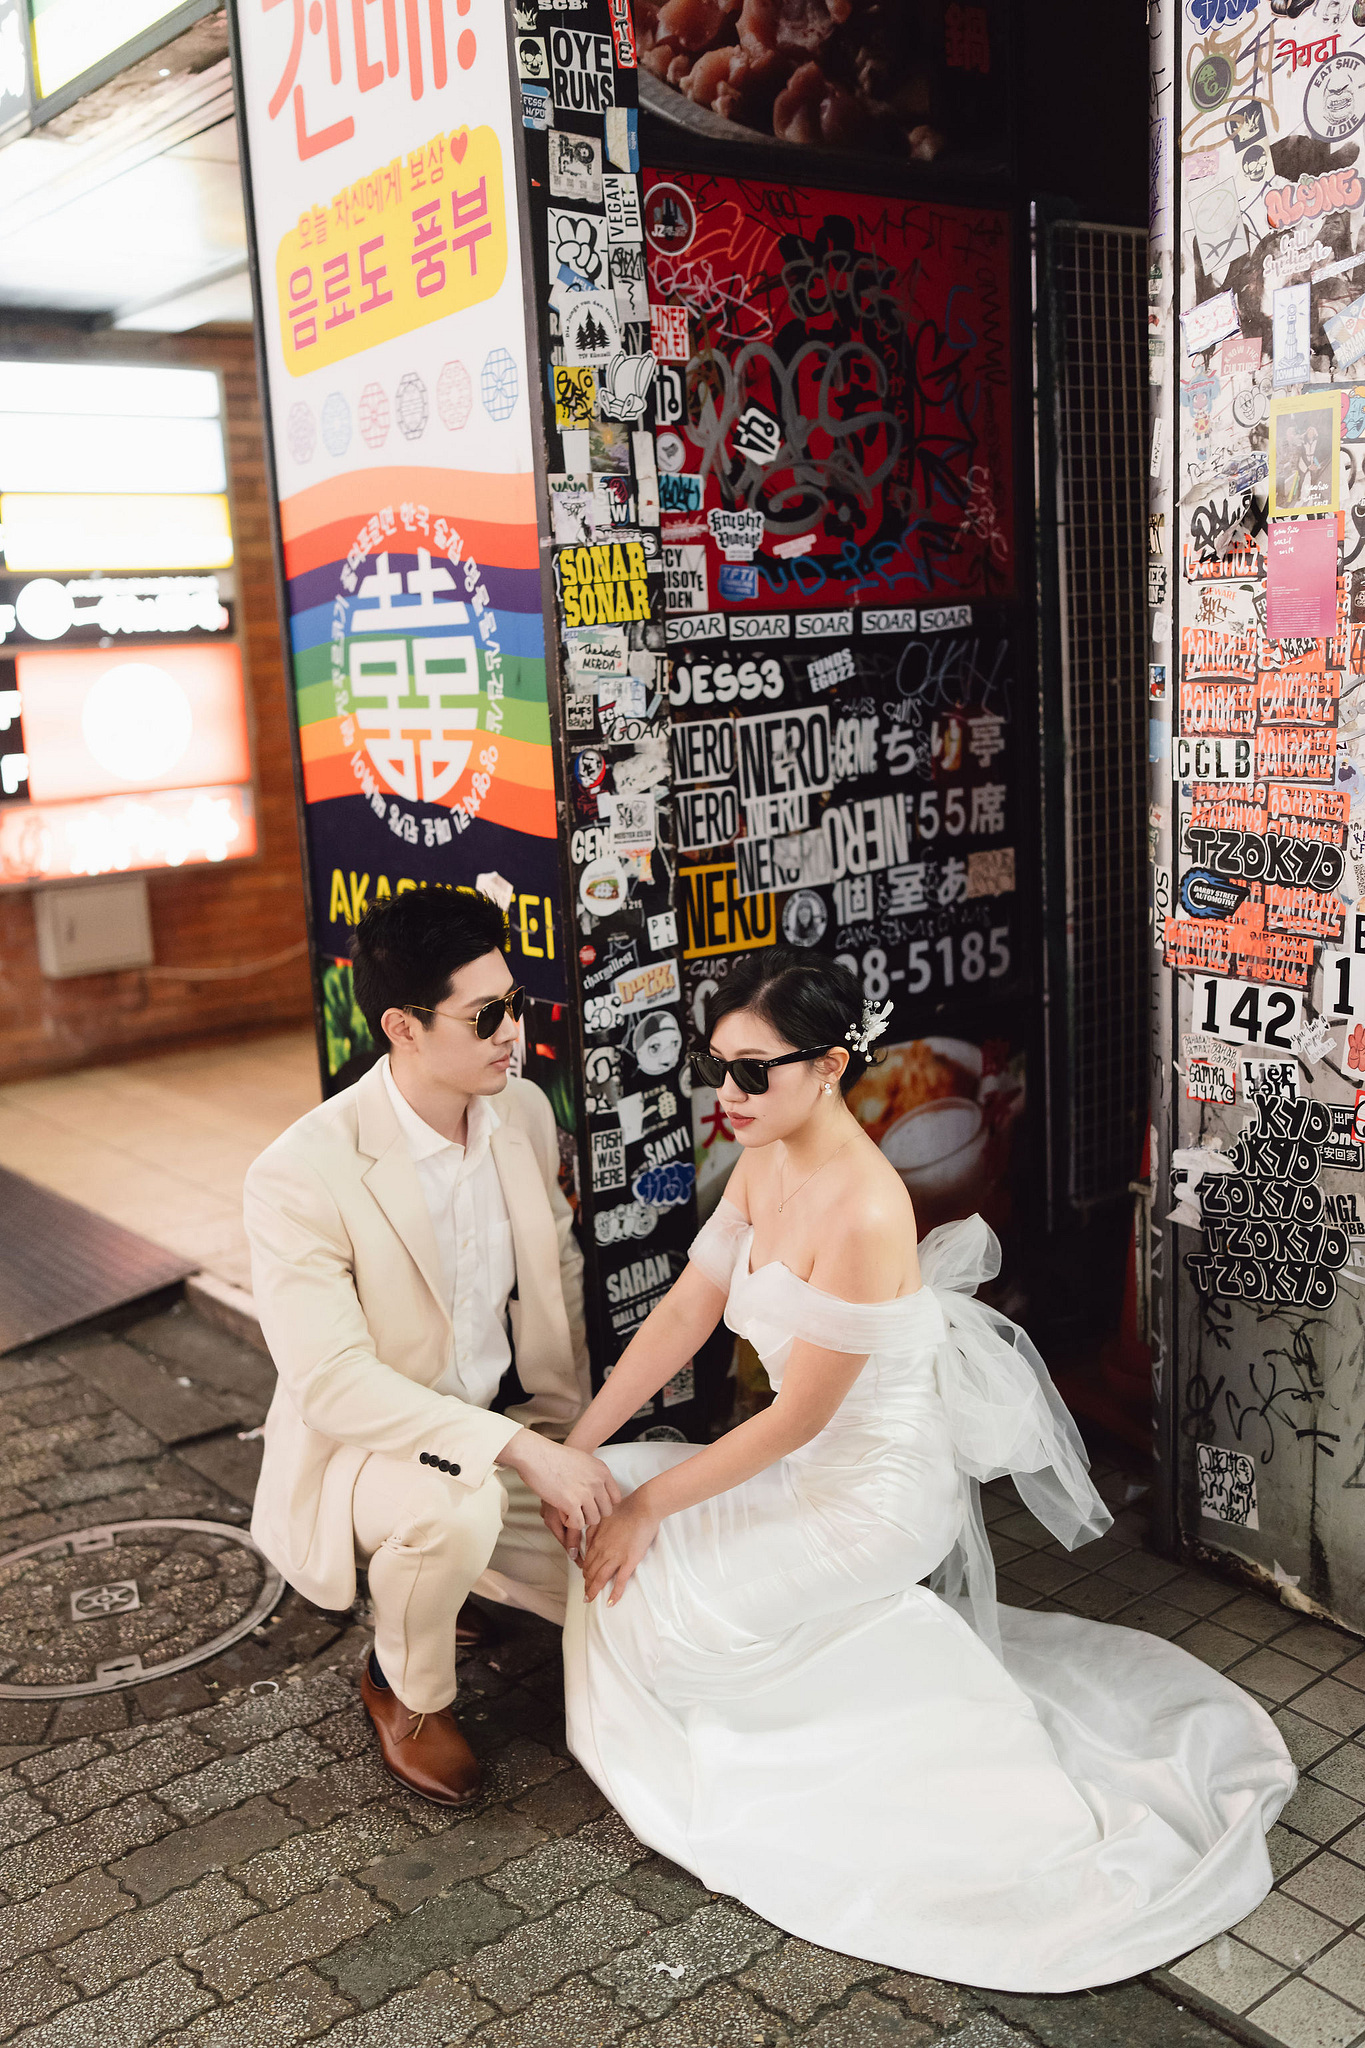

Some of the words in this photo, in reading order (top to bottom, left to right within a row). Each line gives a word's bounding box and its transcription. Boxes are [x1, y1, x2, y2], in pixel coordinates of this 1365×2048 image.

[553, 29, 612, 74] OYE
[1313, 65, 1333, 89] EAT
[1335, 58, 1361, 71] SHIT
[554, 68, 614, 112] RUNS
[1325, 125, 1336, 137] N
[1339, 113, 1360, 135] DIE
[410, 139, 446, 193] 보상
[604, 178, 624, 237] VEGAN
[621, 187, 639, 227] DIET
[1264, 168, 1362, 228] ALONE
[288, 235, 394, 351] 음료도
[411, 176, 492, 299] 풍부
[559, 541, 648, 586] SONAR
[563, 578, 651, 628] SONAR
[863, 611, 914, 632] SOAR
[922, 608, 970, 631] SOAR
[666, 615, 722, 641] SOAR
[732, 617, 787, 638] SOAR
[797, 615, 850, 636] SOAR
[668, 658, 786, 706] JESS3
[806, 648, 853, 679] FUNDS
[671, 720, 736, 782] NERO
[739, 712, 830, 799] NERO
[1177, 739, 1251, 779] CCLB
[676, 789, 736, 849] NERO
[1188, 827, 1346, 892] TZOKYO
[681, 866, 773, 951] NERO
[1193, 884, 1216, 899] DARBY
[1213, 888, 1239, 902] STREET
[1194, 891, 1237, 908] AUTOMOTIVE
[1201, 979, 1297, 1050] 142
[594, 1131, 623, 1152] FOSH
[597, 1149, 621, 1169] WAS
[643, 1125, 692, 1166] SANYI
[592, 1166, 624, 1189] HERE
[1204, 1216, 1350, 1269] TZOKYO
[605, 1252, 672, 1303] SARAN
[1186, 1254, 1337, 1309] TZOKYO
